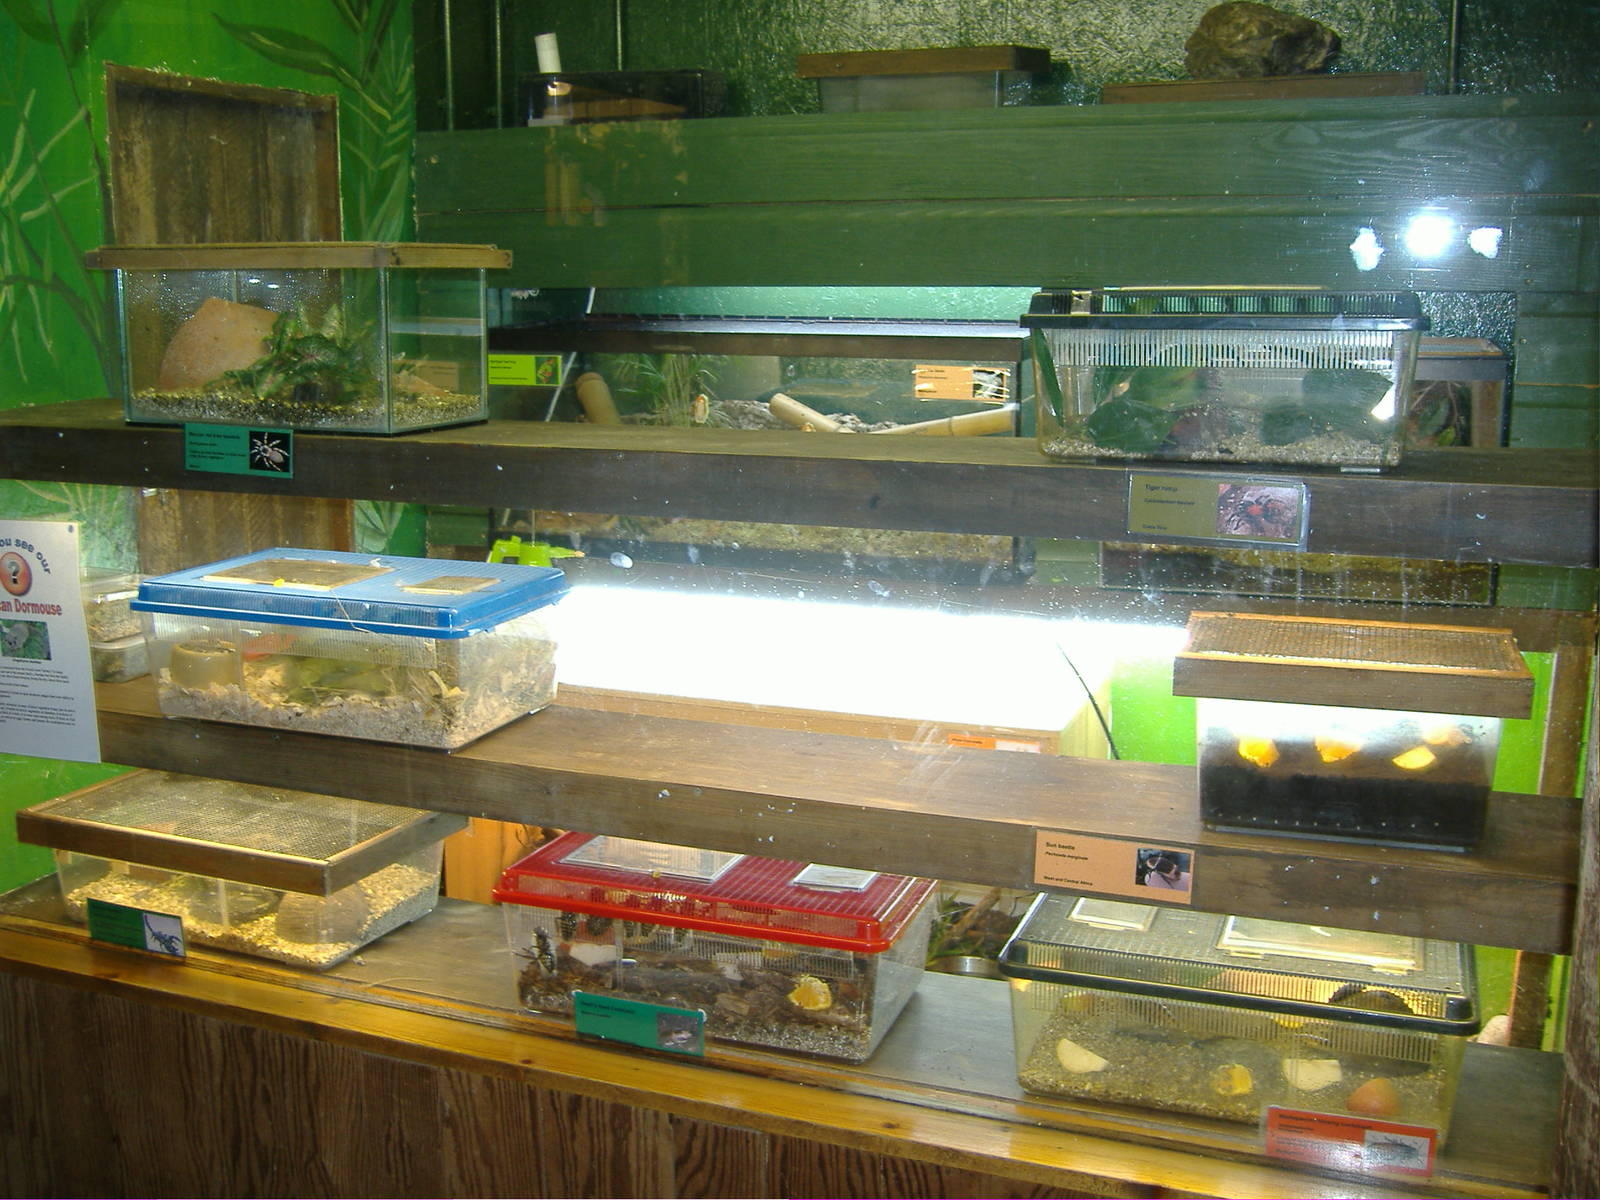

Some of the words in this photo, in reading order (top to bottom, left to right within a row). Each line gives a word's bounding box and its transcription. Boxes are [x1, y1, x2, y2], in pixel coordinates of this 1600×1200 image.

[0, 538, 12, 548] ou
[15, 538, 34, 553] see
[36, 551, 51, 575] our
[14, 598, 62, 616] Dormouse
